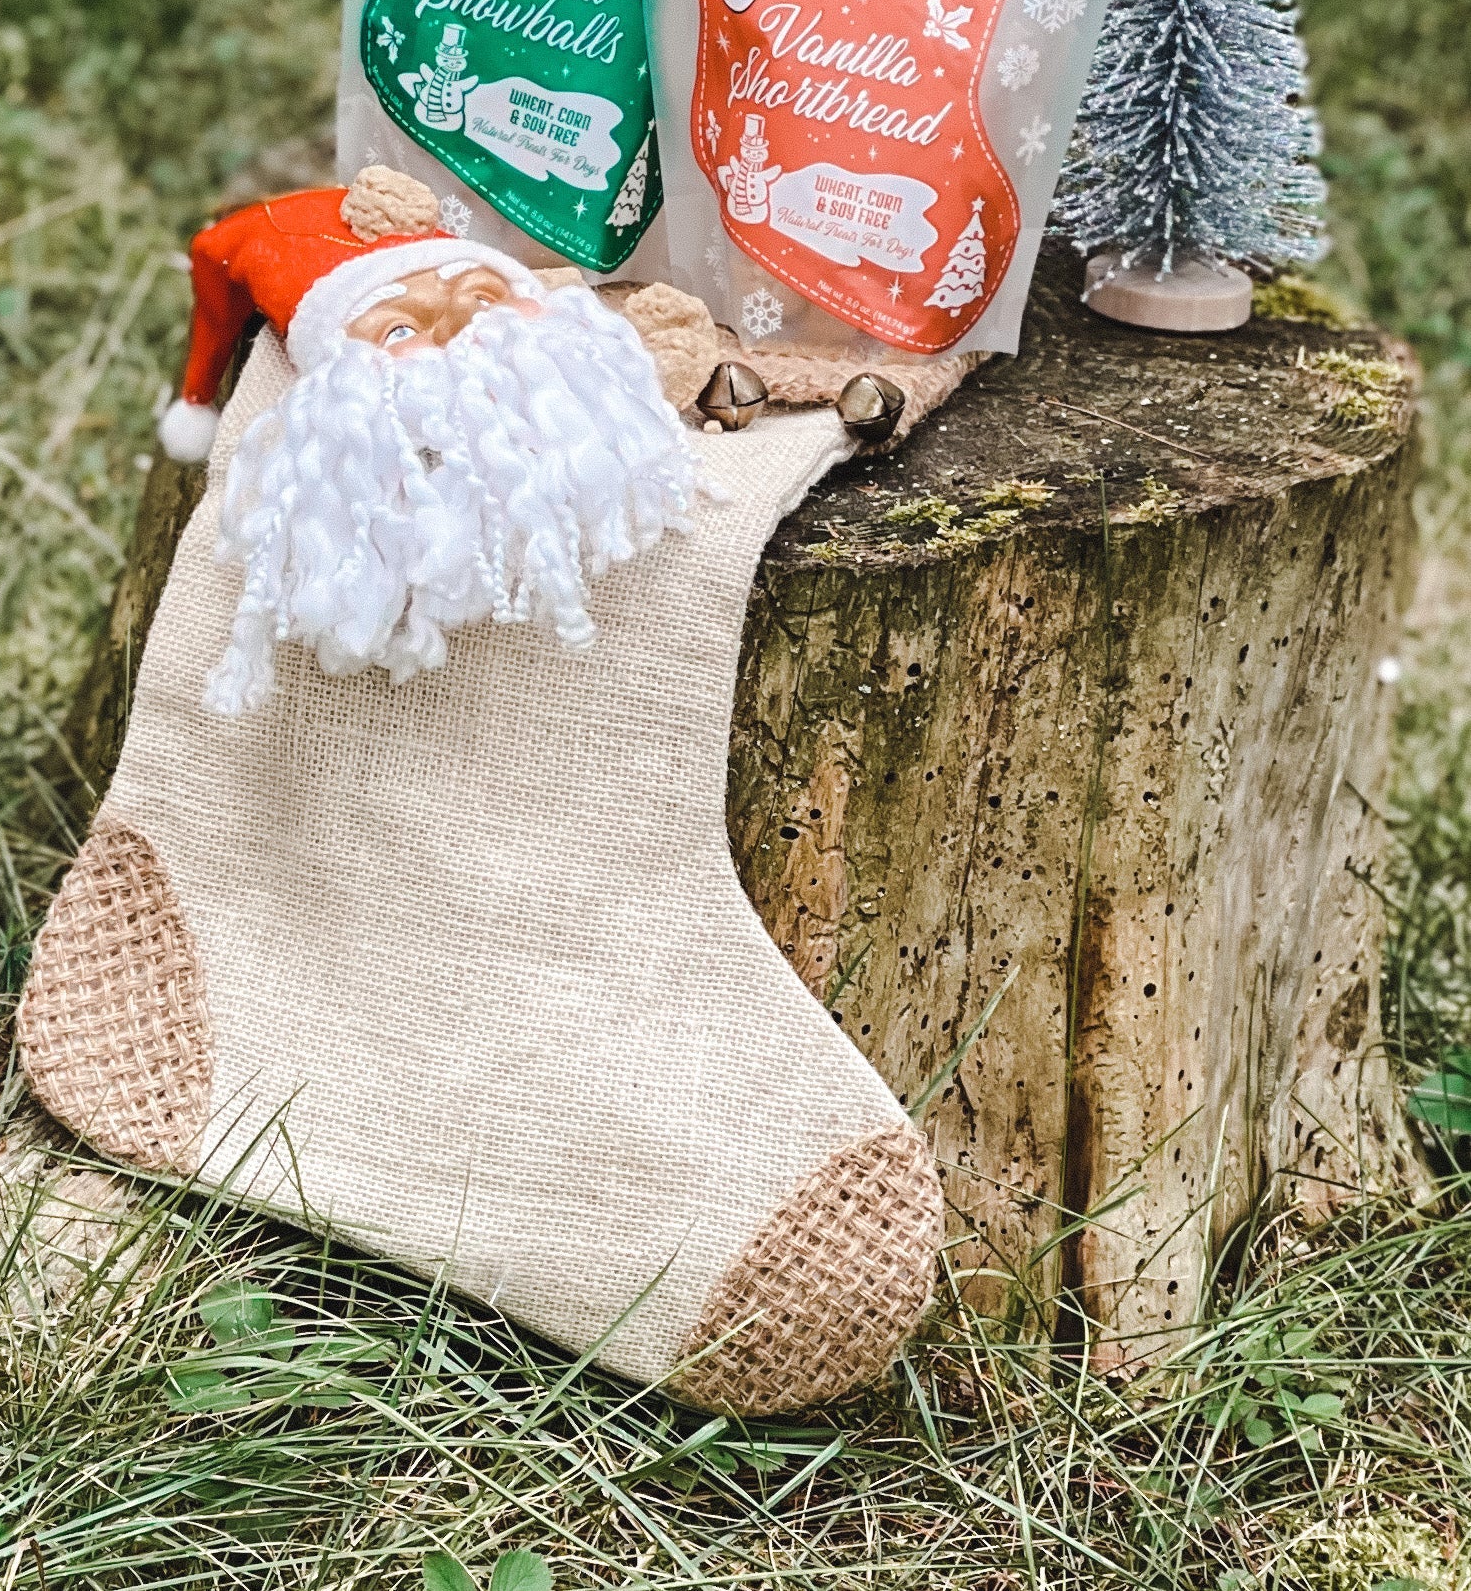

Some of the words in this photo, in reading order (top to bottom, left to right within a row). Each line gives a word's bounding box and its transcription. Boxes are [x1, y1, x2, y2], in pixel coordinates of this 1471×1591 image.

[758, 3, 922, 87] Vanilla
[557, 107, 592, 130] CORN
[727, 46, 953, 146] Shortbread
[472, 117, 517, 143] Natural
[516, 134, 548, 156] Treats
[550, 148, 570, 164] For
[573, 156, 601, 177] Dogs
[510, 110, 519, 125] &
[522, 113, 547, 135] SOY
[548, 124, 580, 146] FREE
[815, 175, 863, 204] WHEAT,
[868, 190, 903, 213] CORN
[816, 196, 826, 213] &
[829, 200, 856, 220] SOY
[858, 208, 891, 230] FREE
[777, 206, 825, 231] Natural
[823, 221, 858, 242] Treats
[861, 232, 883, 248] For
[886, 238, 914, 259] Dogs
